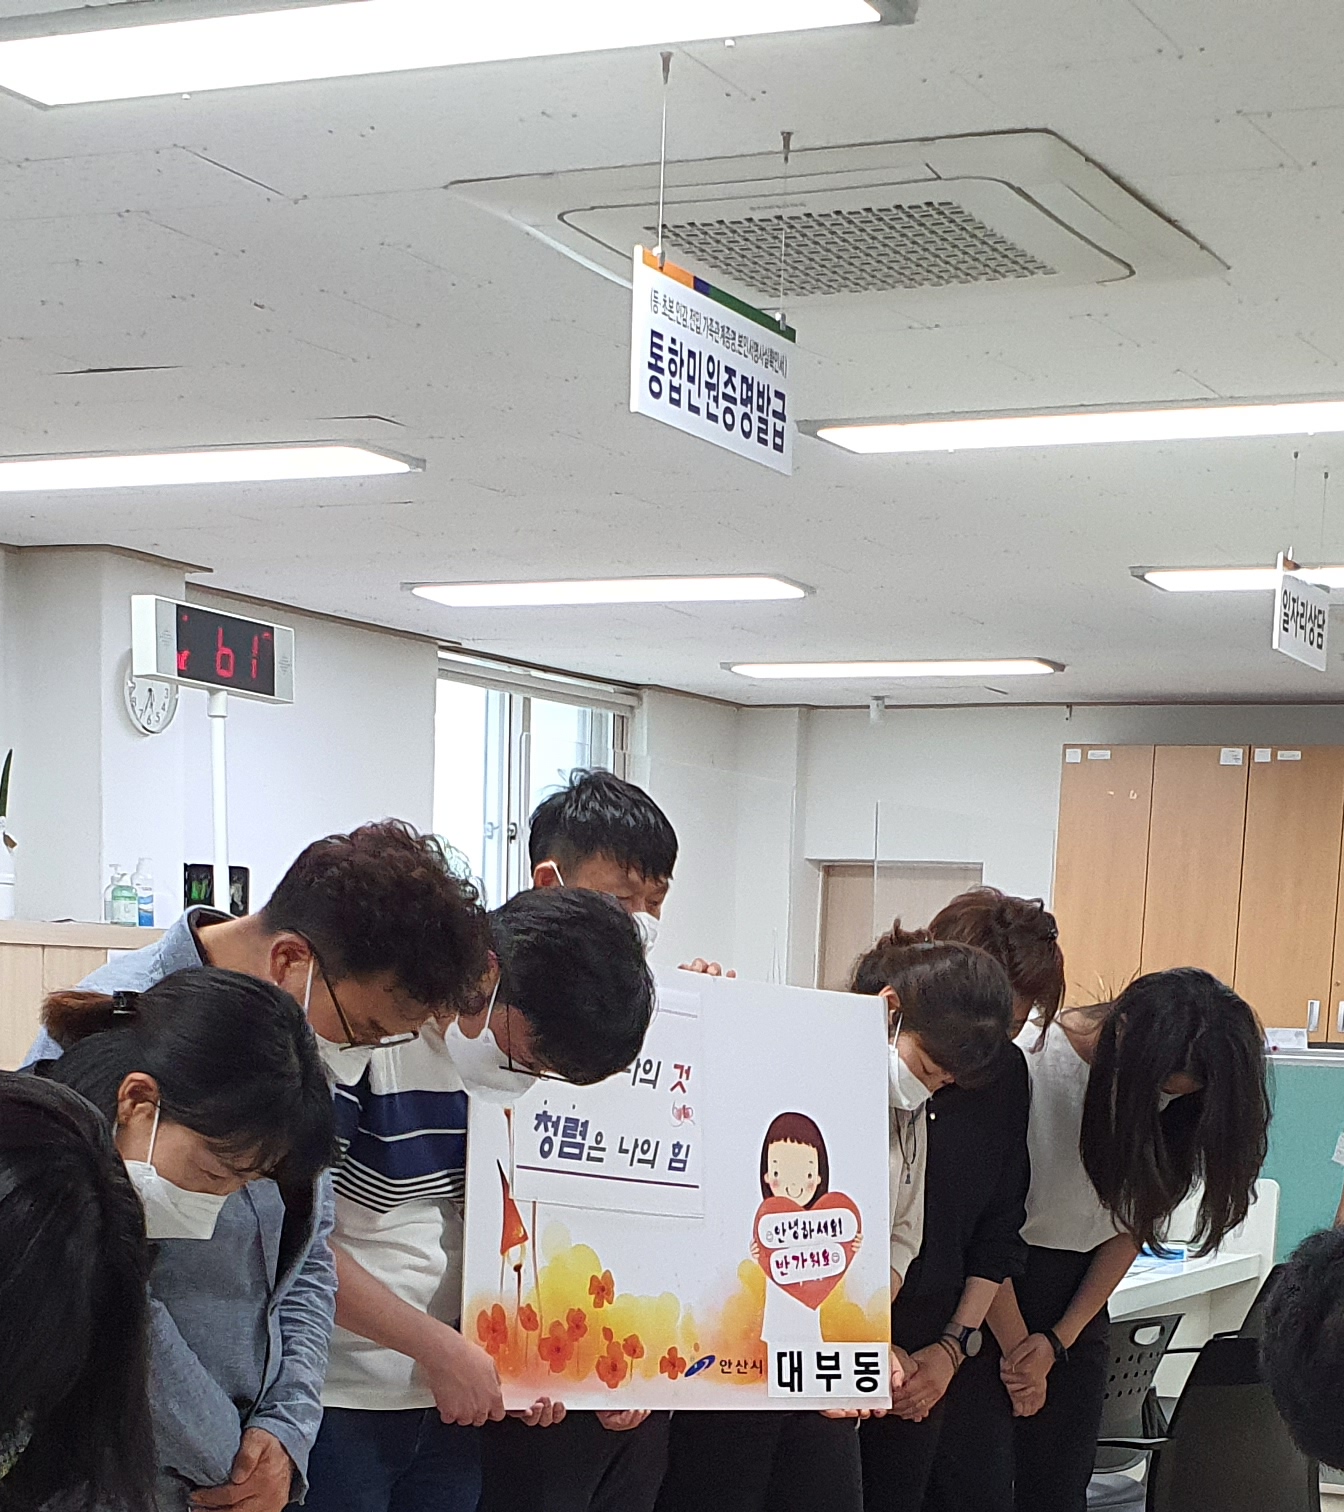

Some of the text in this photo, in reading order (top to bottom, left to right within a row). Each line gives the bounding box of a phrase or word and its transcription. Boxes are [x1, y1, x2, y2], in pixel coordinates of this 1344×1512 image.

[647, 329, 787, 454] 통합민원증명발급
[1282, 588, 1326, 651] 일자리상담
[670, 1063, 692, 1094] 것
[534, 1099, 691, 1172] 청렴은 나의 힘
[774, 1218, 843, 1243] 안녕하세요!
[719, 1358, 763, 1375] 안산시
[776, 1350, 881, 1393] 대부동
